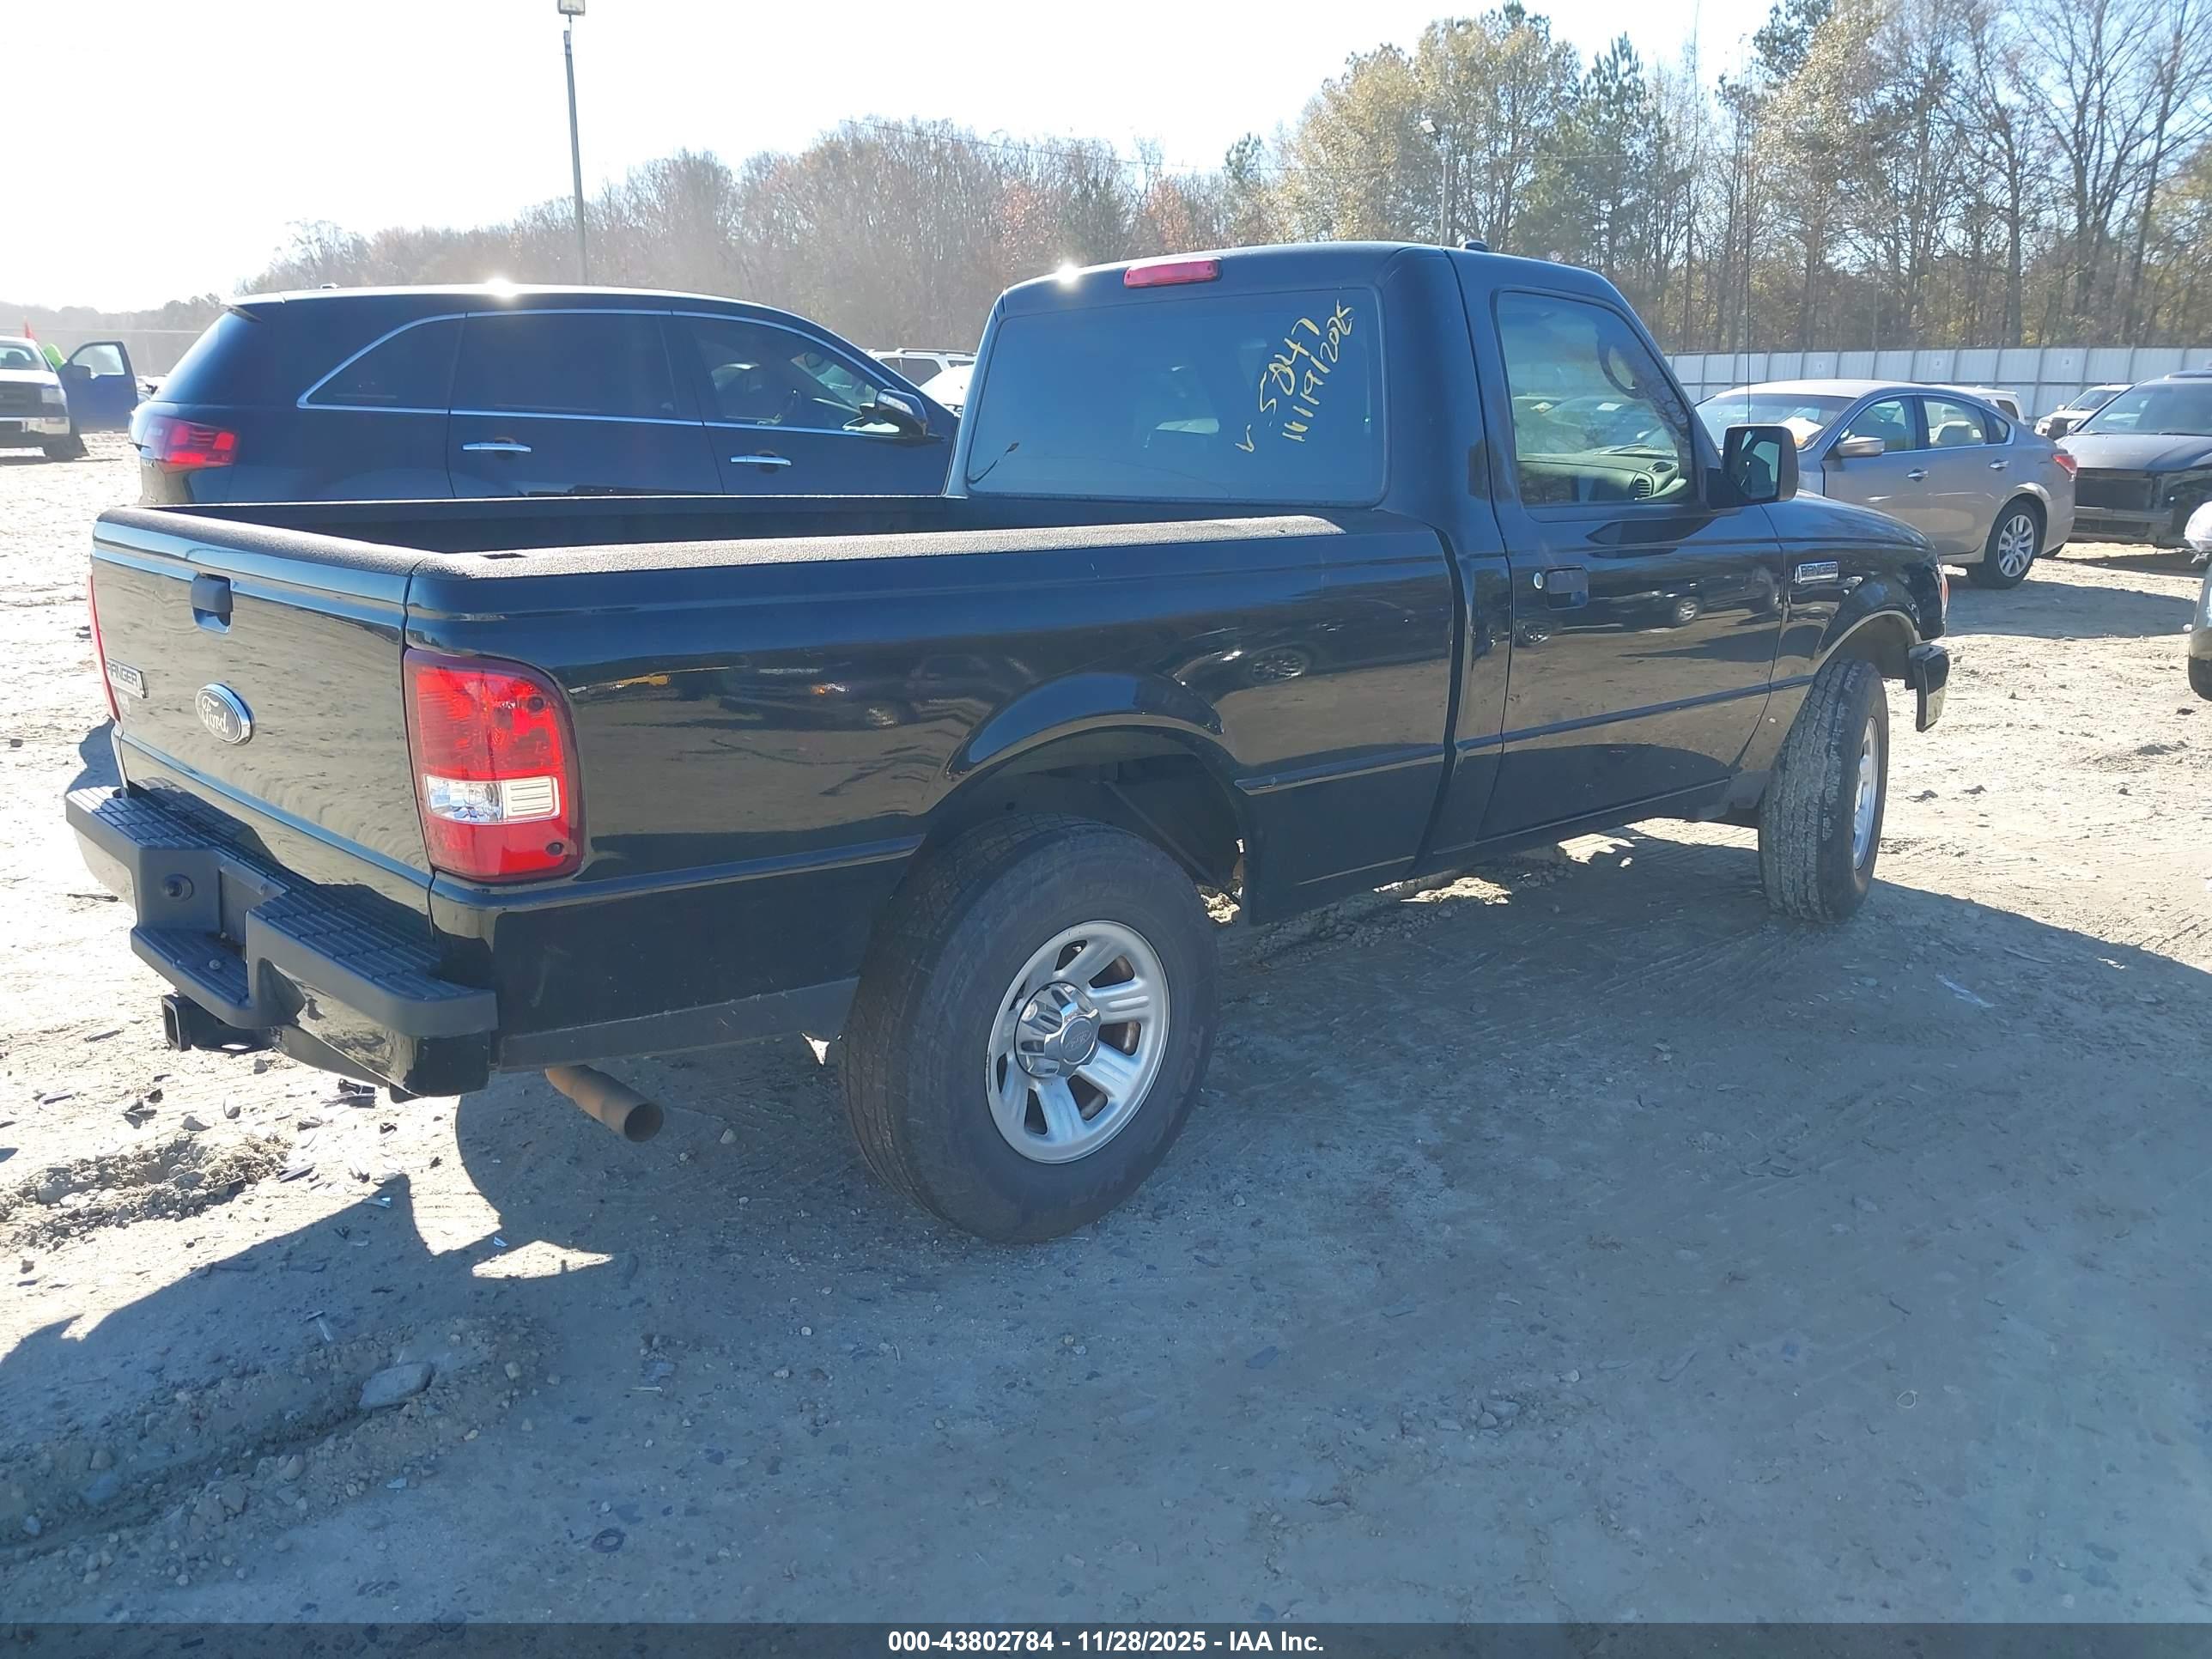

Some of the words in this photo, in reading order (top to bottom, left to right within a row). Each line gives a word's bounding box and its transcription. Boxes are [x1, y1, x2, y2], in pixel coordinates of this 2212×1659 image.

[1800, 563, 1838, 578] RANGER
[106, 660, 138, 688] RANGER
[200, 695, 229, 735] Ford
